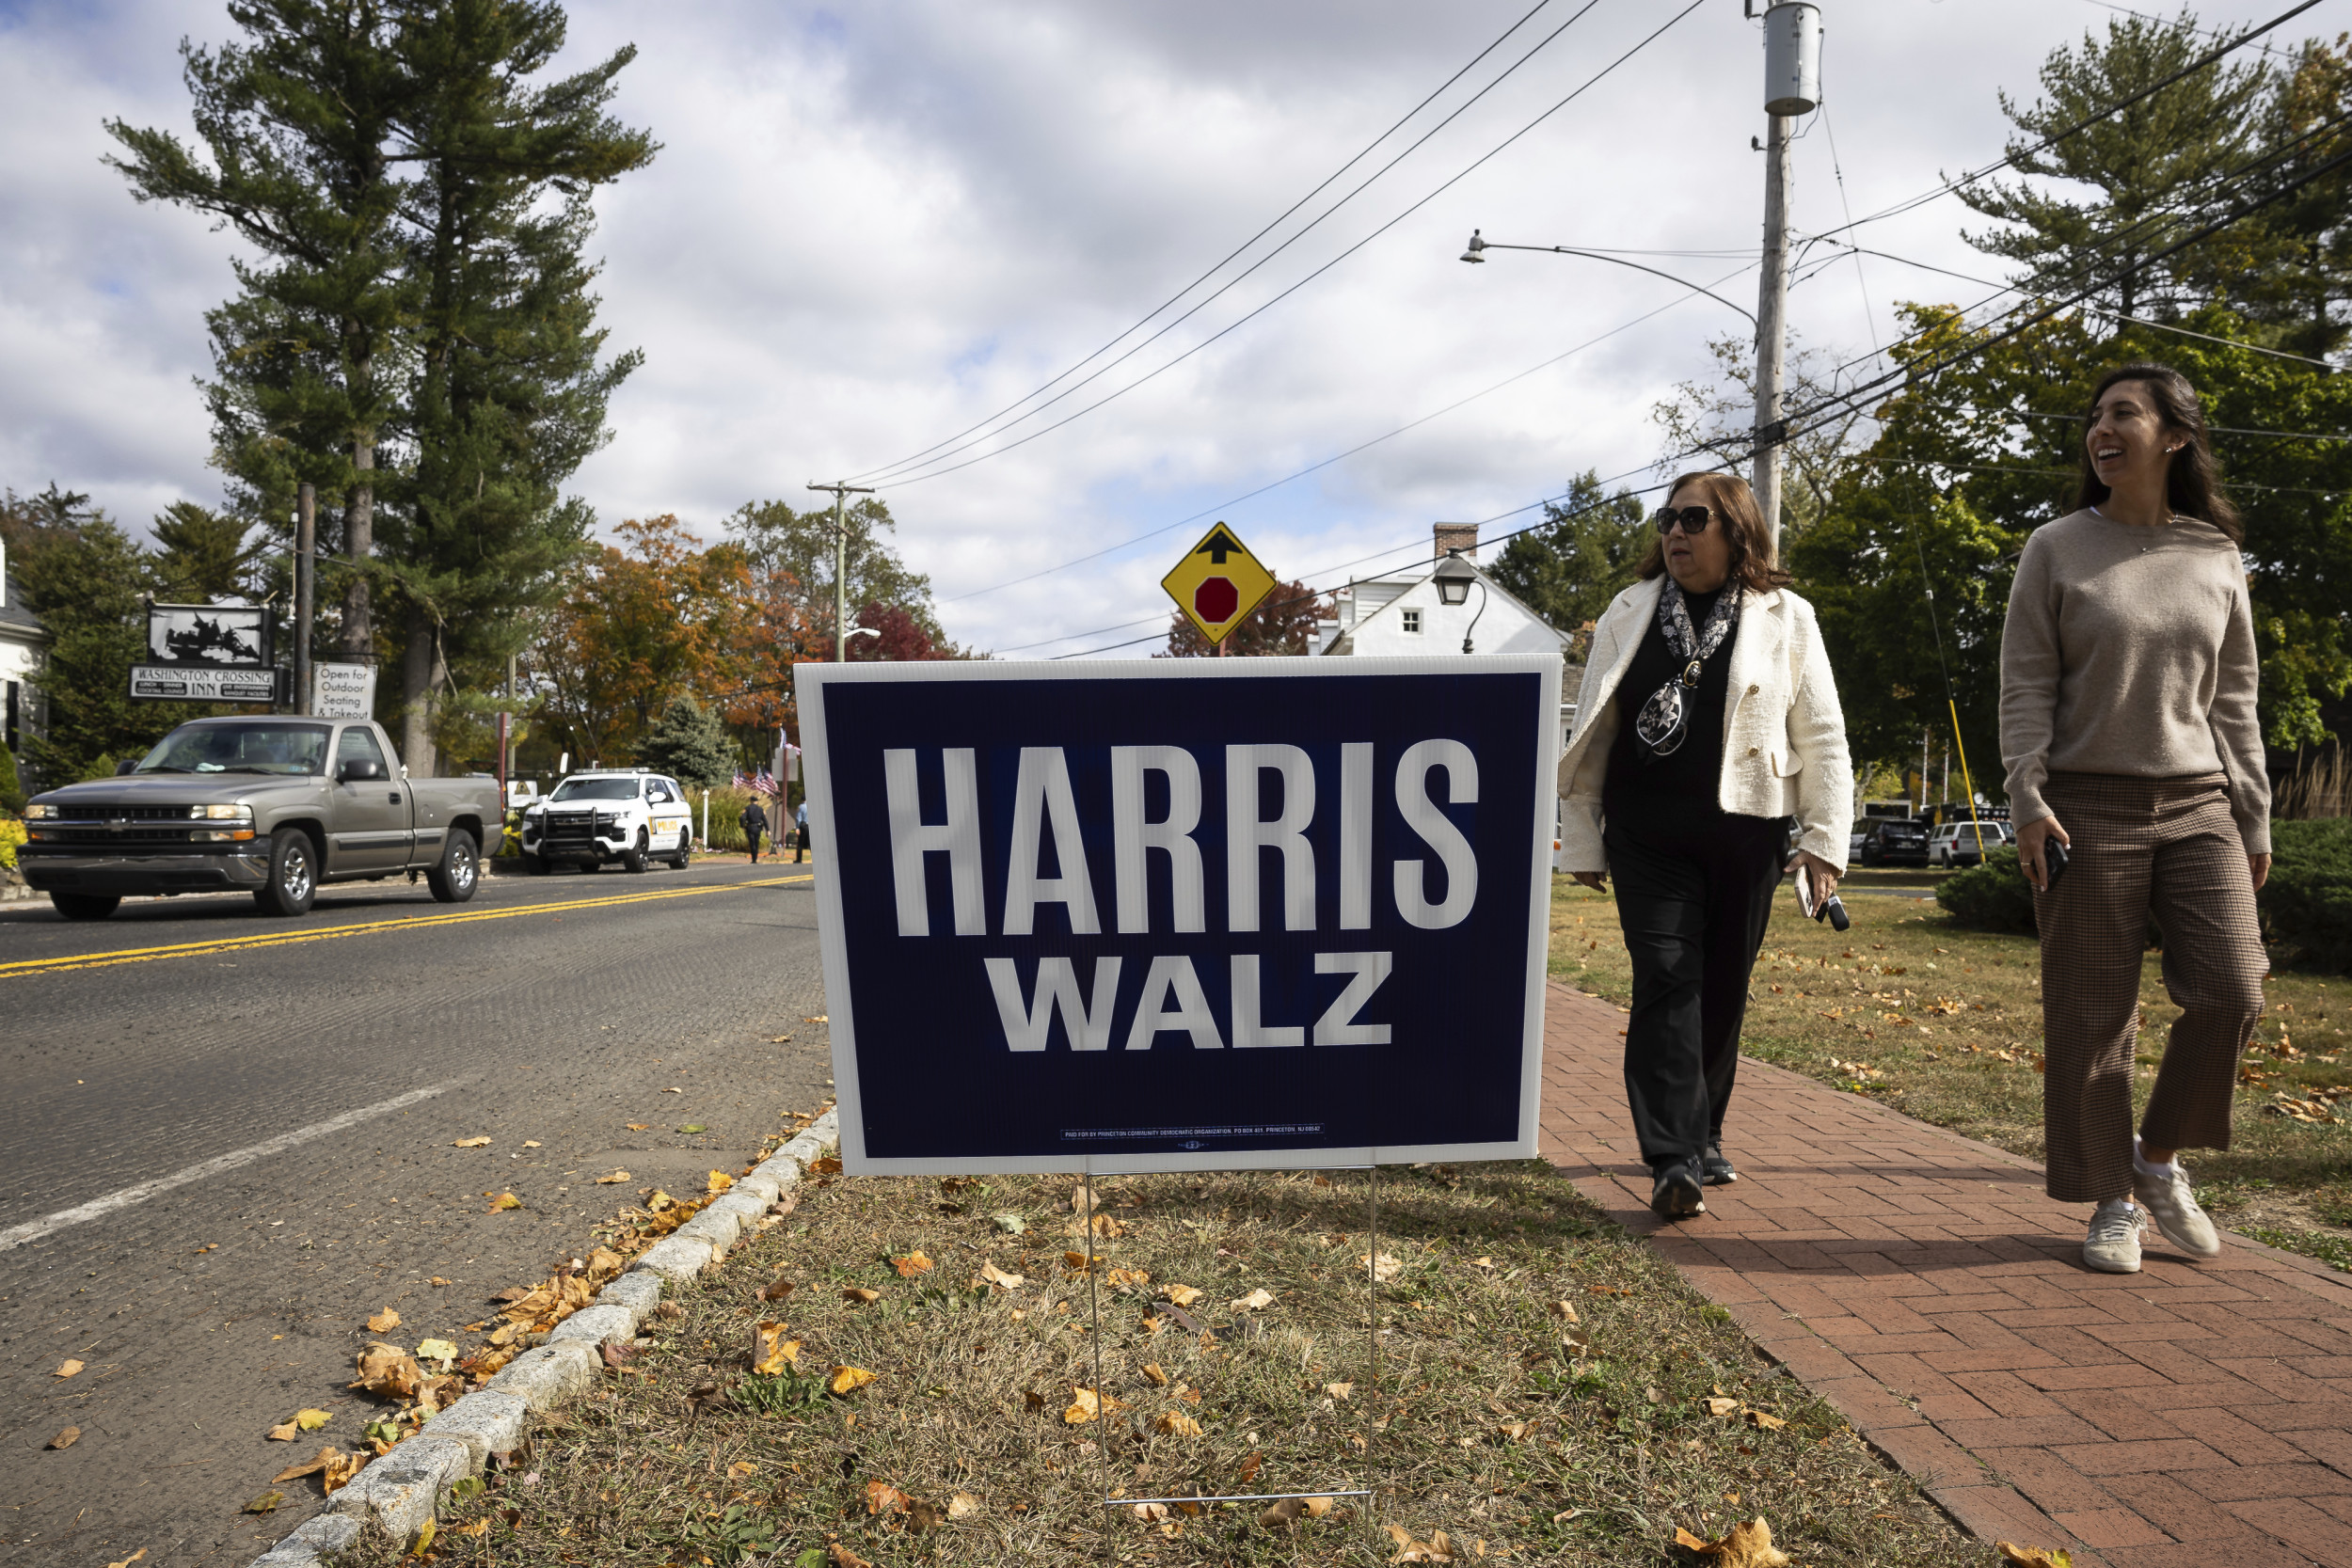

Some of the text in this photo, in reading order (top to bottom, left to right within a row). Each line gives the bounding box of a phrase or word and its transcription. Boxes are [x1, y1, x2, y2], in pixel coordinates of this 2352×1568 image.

[138, 669, 270, 683] WASHINGTON CROSSING
[321, 668, 367, 680] Open for
[192, 683, 215, 696] INN
[322, 681, 364, 692] Outdoor
[324, 695, 360, 708] Seating
[319, 707, 368, 719] & Takeout
[884, 739, 1479, 936] HARRIS
[984, 952, 1392, 1052] WALZ
